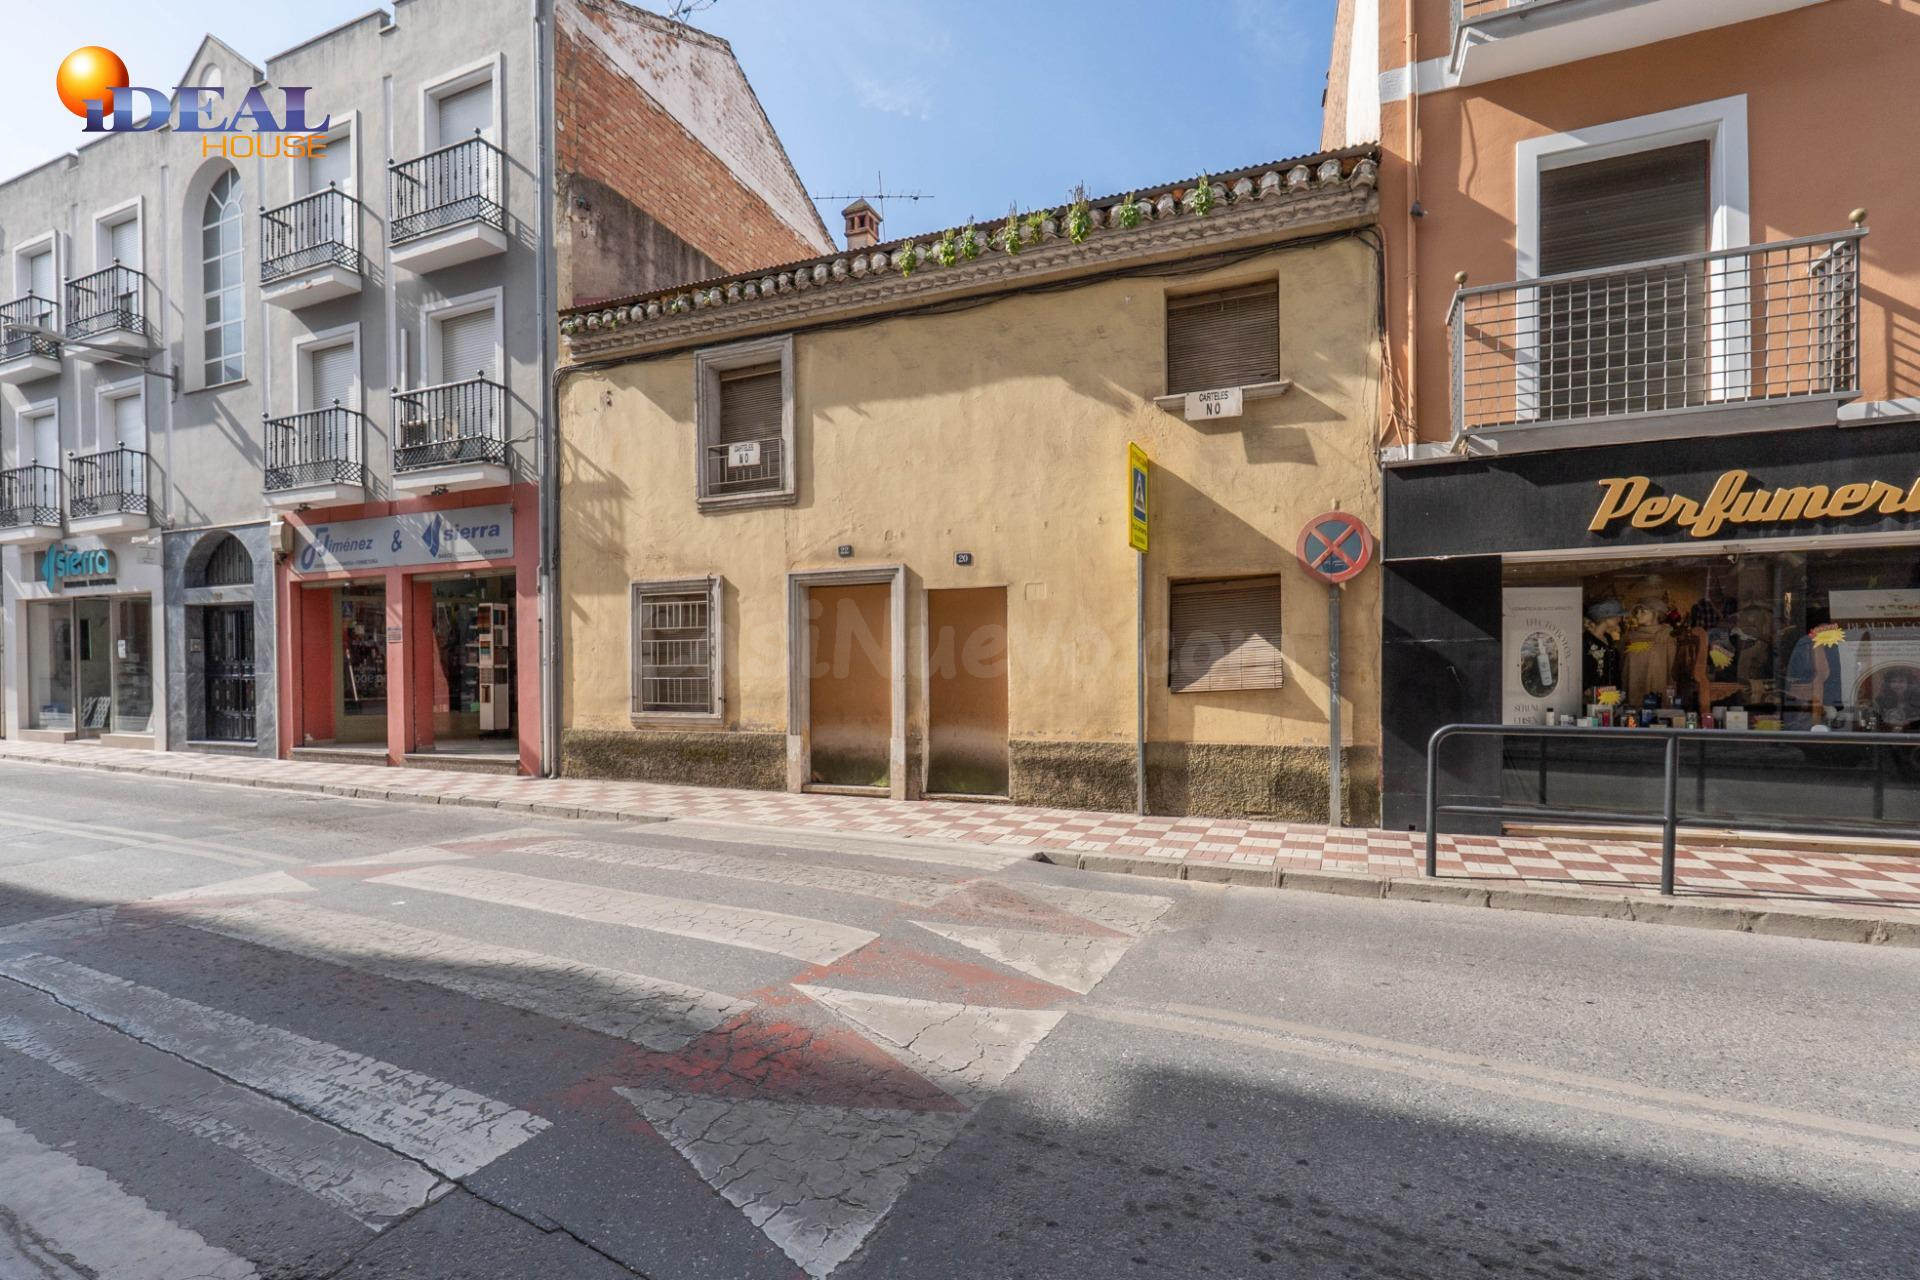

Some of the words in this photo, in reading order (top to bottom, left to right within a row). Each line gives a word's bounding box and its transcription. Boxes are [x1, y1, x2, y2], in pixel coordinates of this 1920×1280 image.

[1199, 390, 1229, 402] CARTELES
[391, 529, 402, 552] &
[443, 523, 500, 541] sierra
[56, 544, 109, 577] sierra
[958, 554, 969, 564] 20
